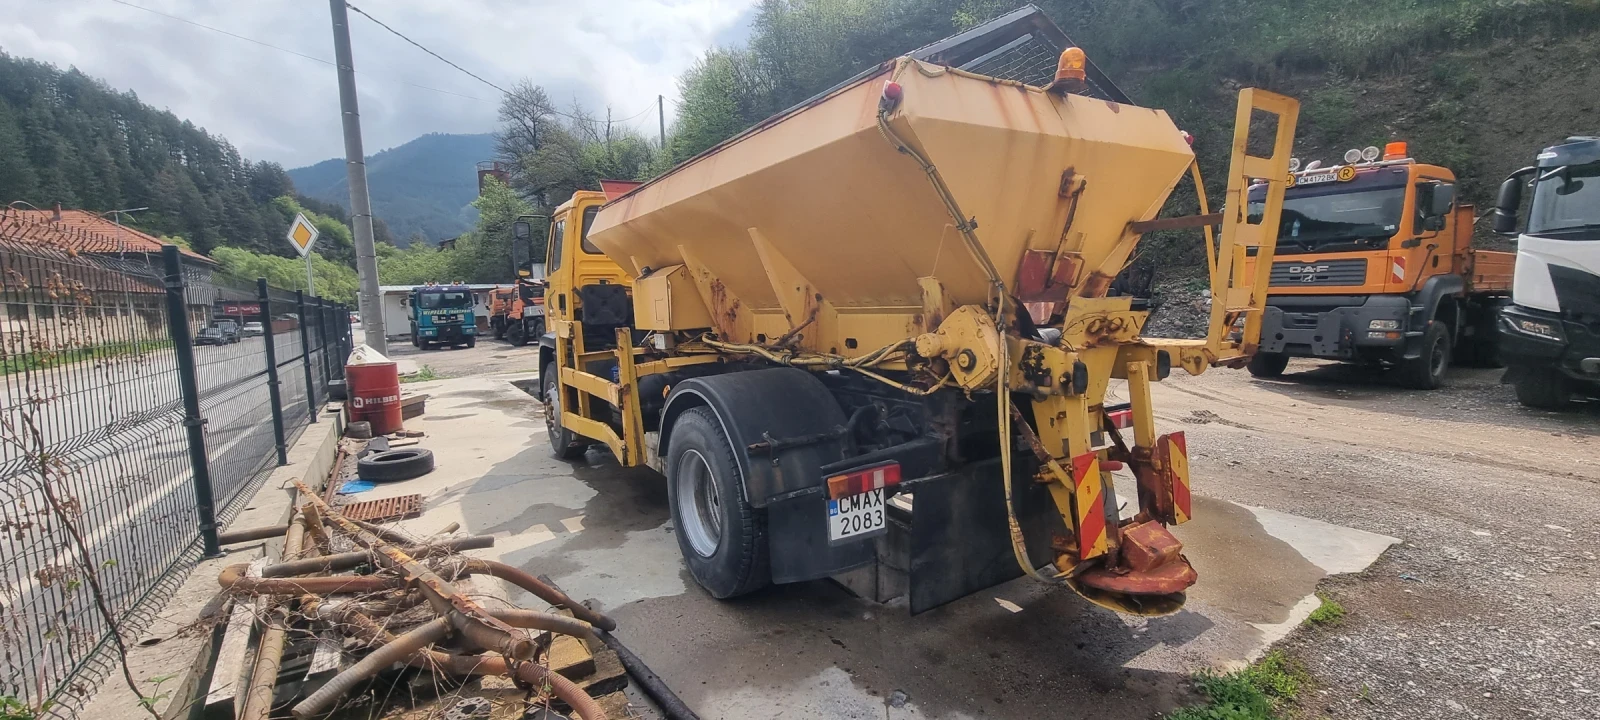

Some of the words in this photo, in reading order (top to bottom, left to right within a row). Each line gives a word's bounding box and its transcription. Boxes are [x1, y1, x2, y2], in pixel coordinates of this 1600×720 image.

[1342, 168, 1350, 178] R
[366, 395, 398, 404] HILBER
[840, 490, 882, 514] CMAX
[840, 510, 883, 535] 2083
